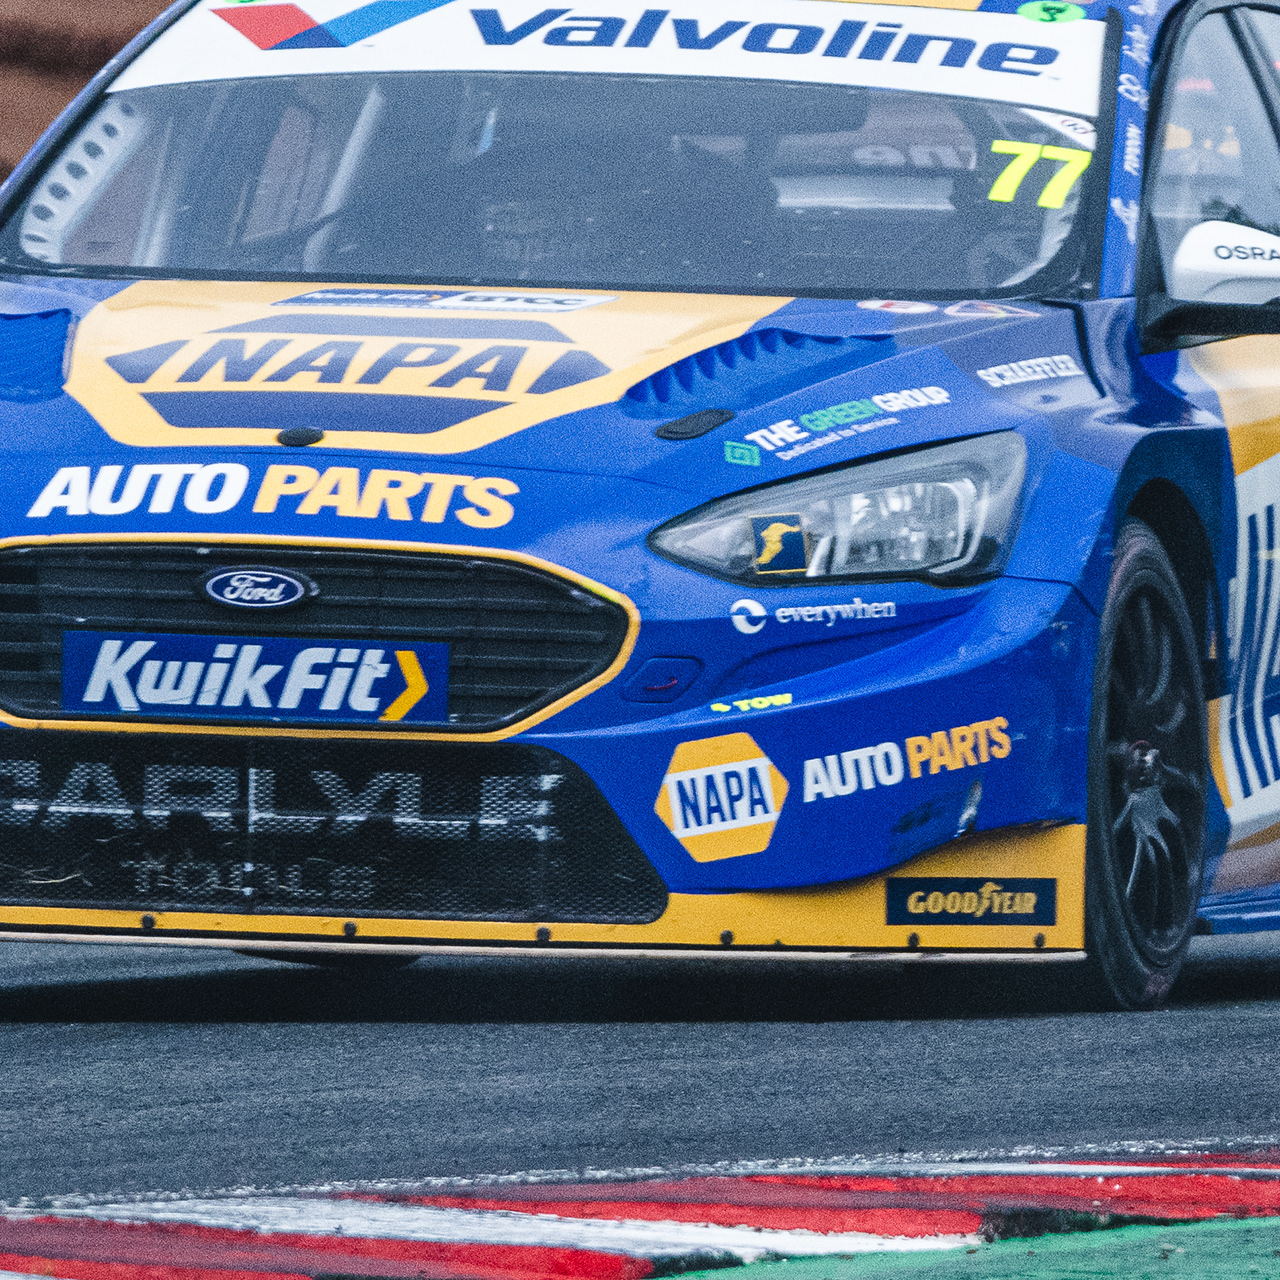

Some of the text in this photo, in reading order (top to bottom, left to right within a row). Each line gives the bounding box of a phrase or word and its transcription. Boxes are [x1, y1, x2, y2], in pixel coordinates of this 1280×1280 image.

[469, 7, 1060, 77] Valvoline
[988, 139, 1092, 209] 77
[176, 337, 527, 393] NAPA
[744, 385, 952, 451] THE GREEN GROUP
[26, 462, 521, 529] AUTO PARTS
[223, 574, 288, 601] Ford
[775, 597, 897, 627] everywhen
[732, 693, 792, 712] TOW
[803, 716, 1012, 803] AUTO PARTS
[676, 766, 771, 830] NAPA
